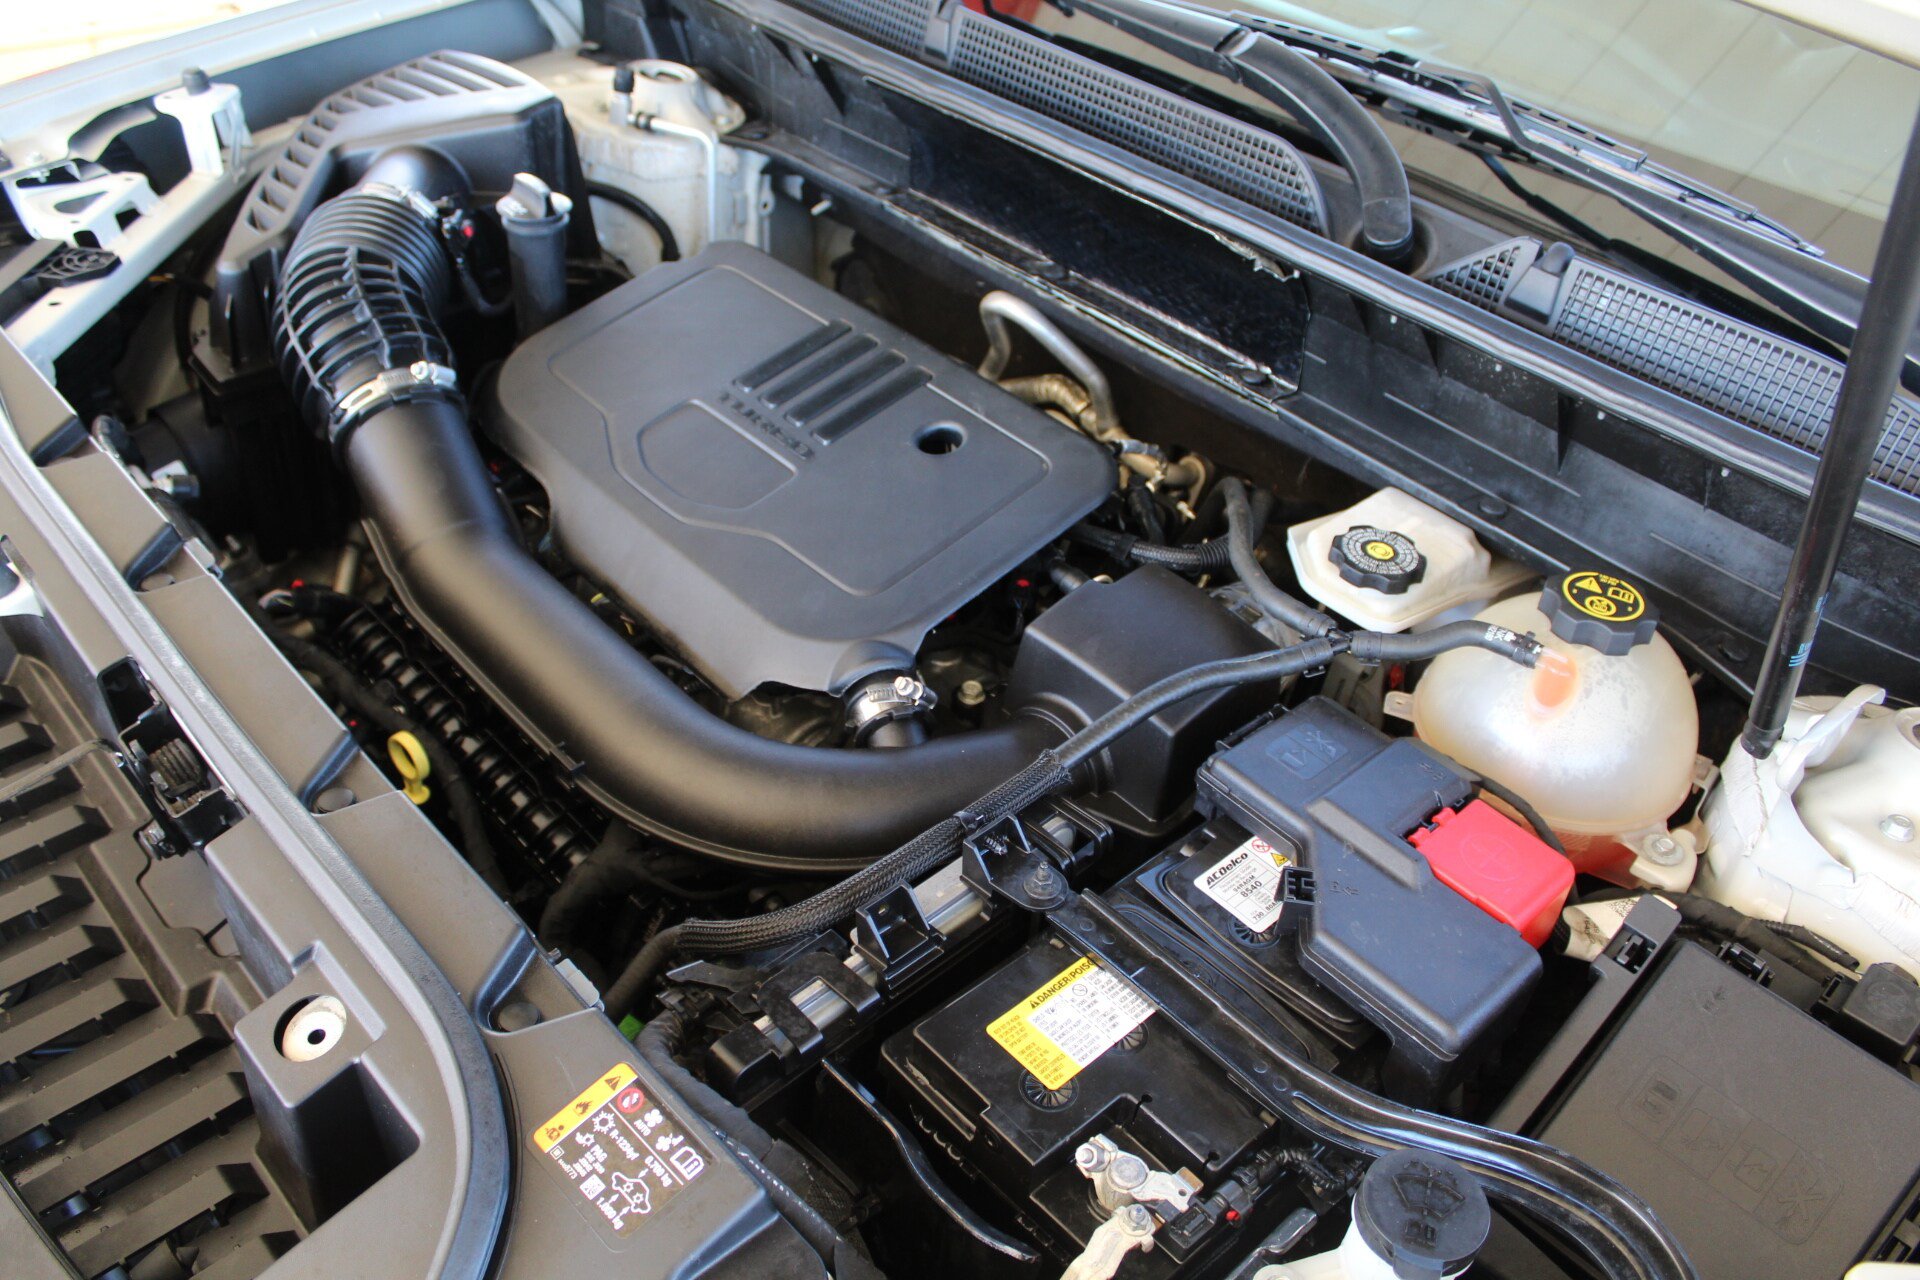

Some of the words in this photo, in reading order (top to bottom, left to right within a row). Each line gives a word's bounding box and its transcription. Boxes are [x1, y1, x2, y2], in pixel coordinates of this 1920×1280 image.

[1206, 852, 1248, 885] ACDelco
[1240, 880, 1262, 898] 8540
[633, 1119, 652, 1137] AUTO
[590, 1144, 608, 1163] PAG
[609, 1128, 640, 1161] R-1234yf
[660, 1173, 673, 1188] kg
[612, 1217, 624, 1231] kg
